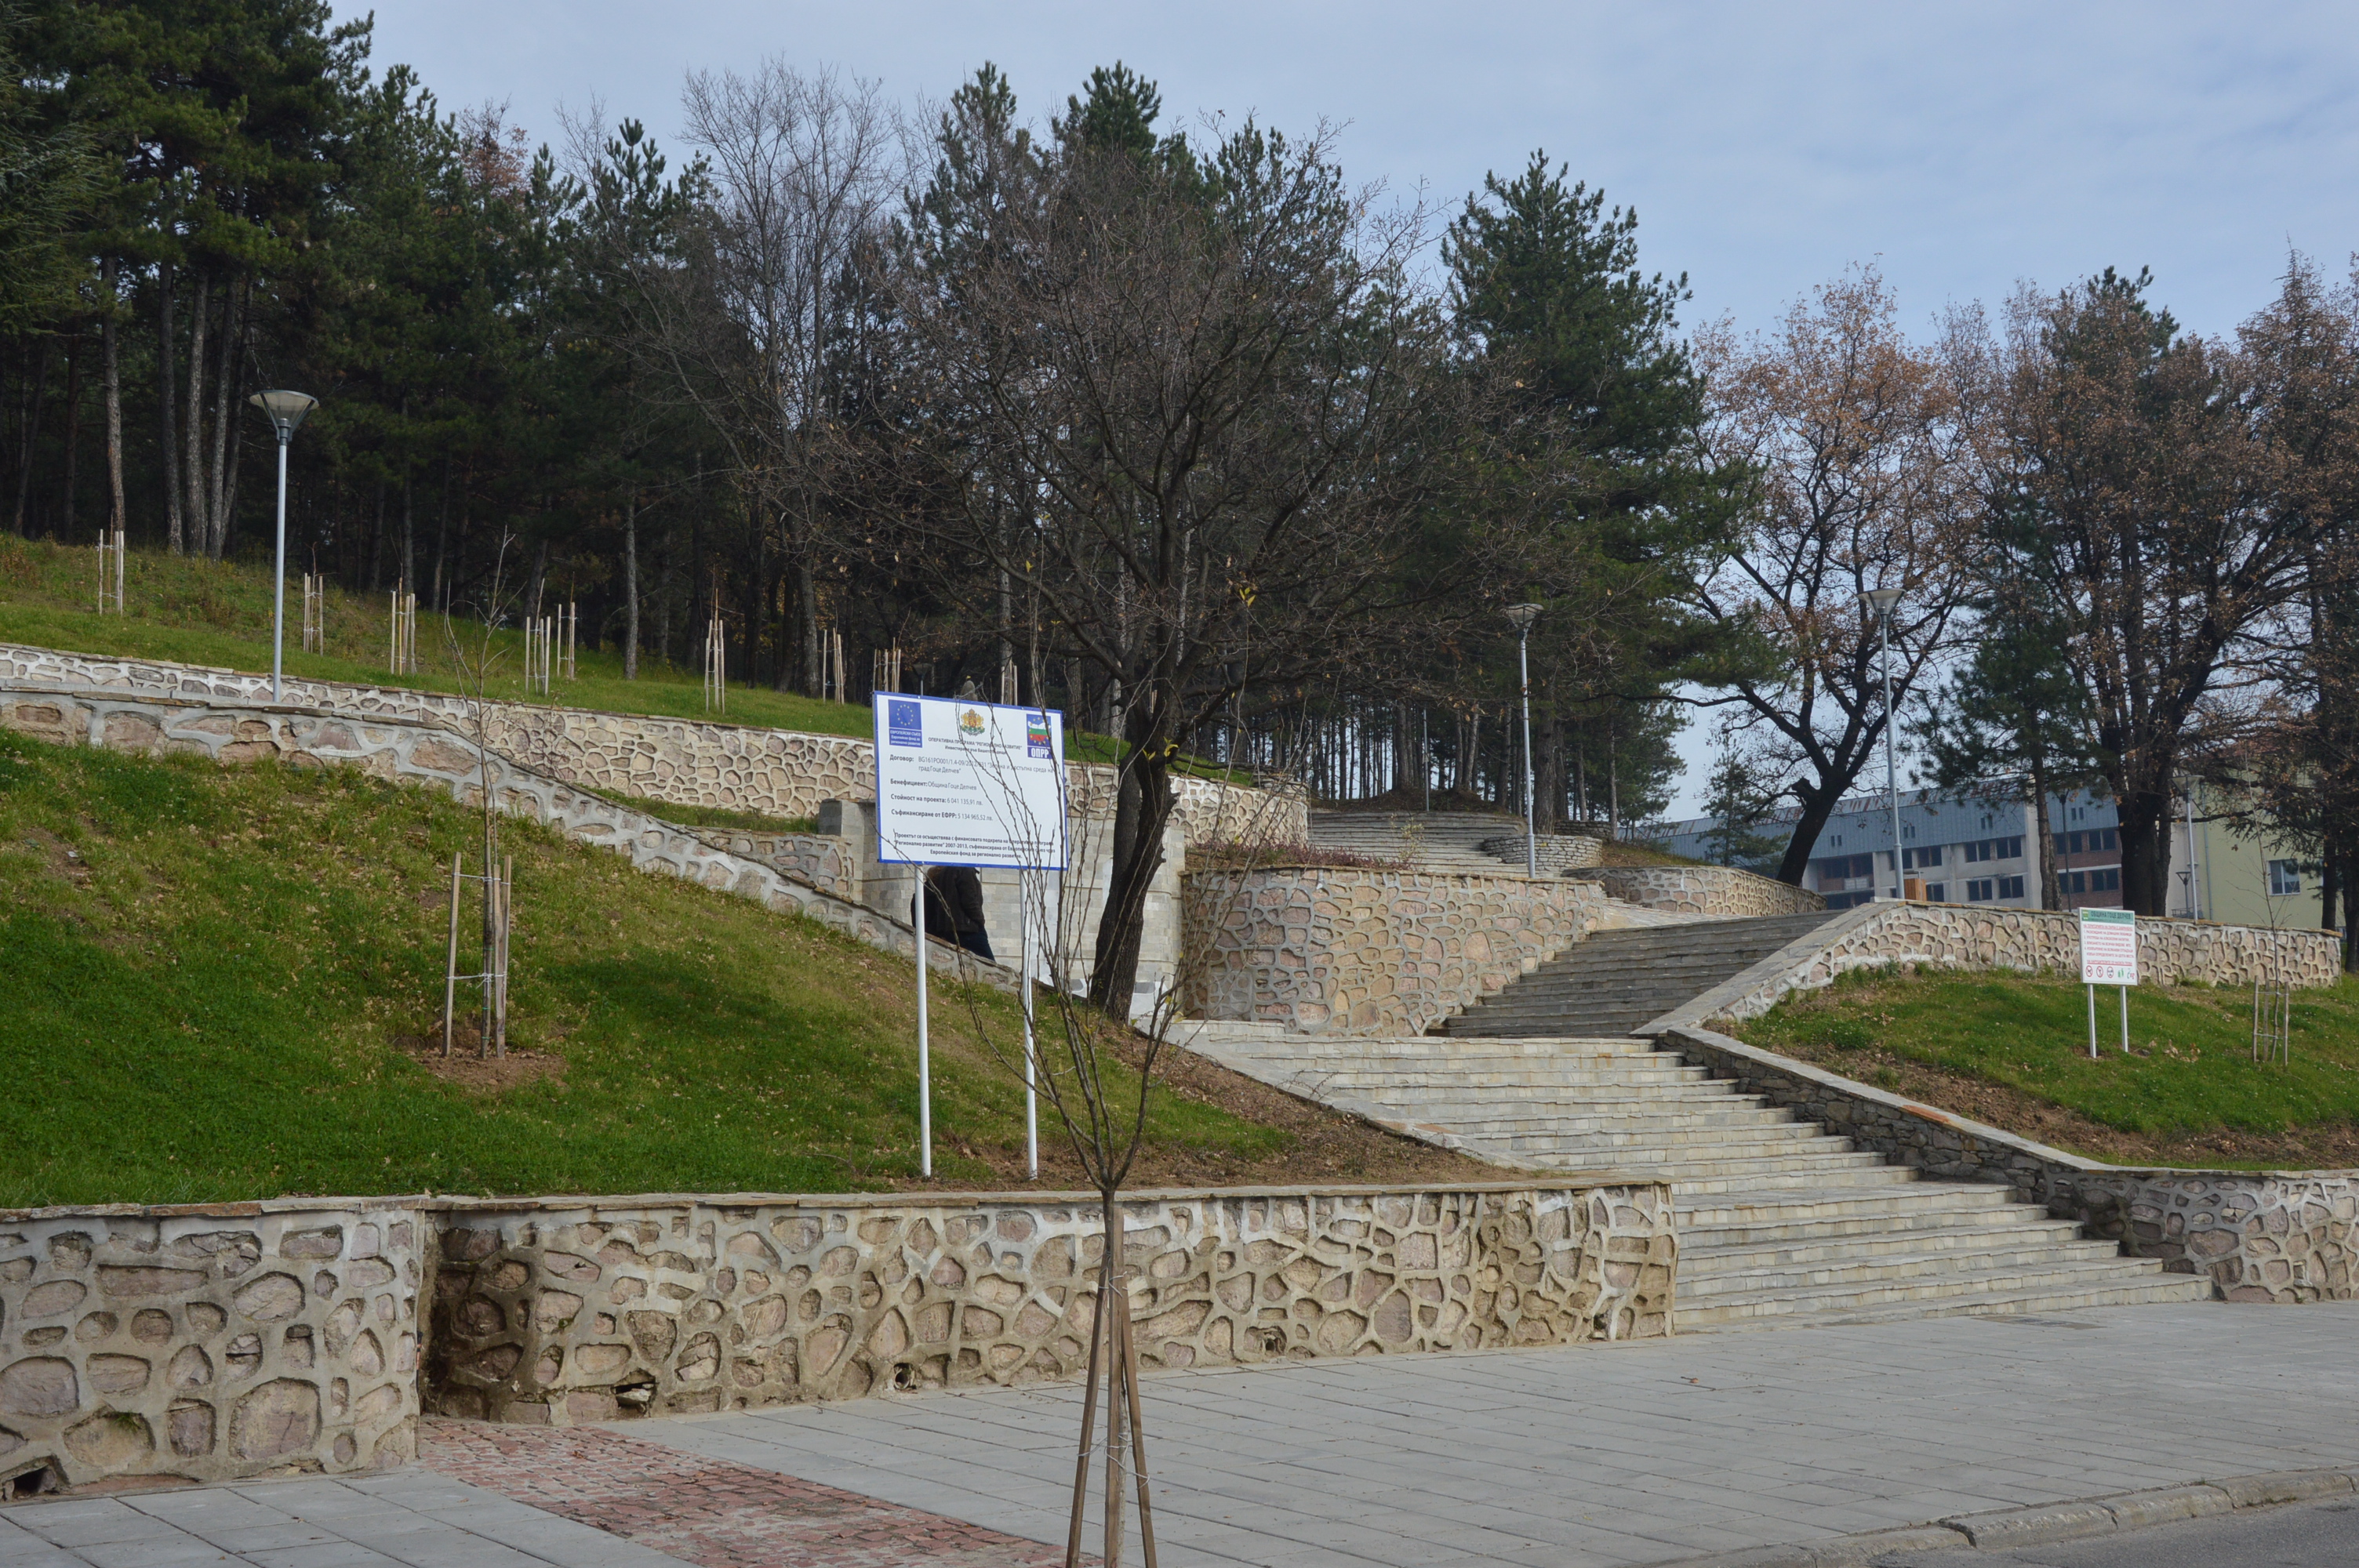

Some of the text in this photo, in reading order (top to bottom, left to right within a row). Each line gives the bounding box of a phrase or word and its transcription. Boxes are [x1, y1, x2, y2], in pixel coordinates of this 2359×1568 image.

[1031, 747, 1049, 758] ОПРР
[890, 778, 927, 786] Бенефициент:
[891, 809, 933, 818] Съфинансиране
